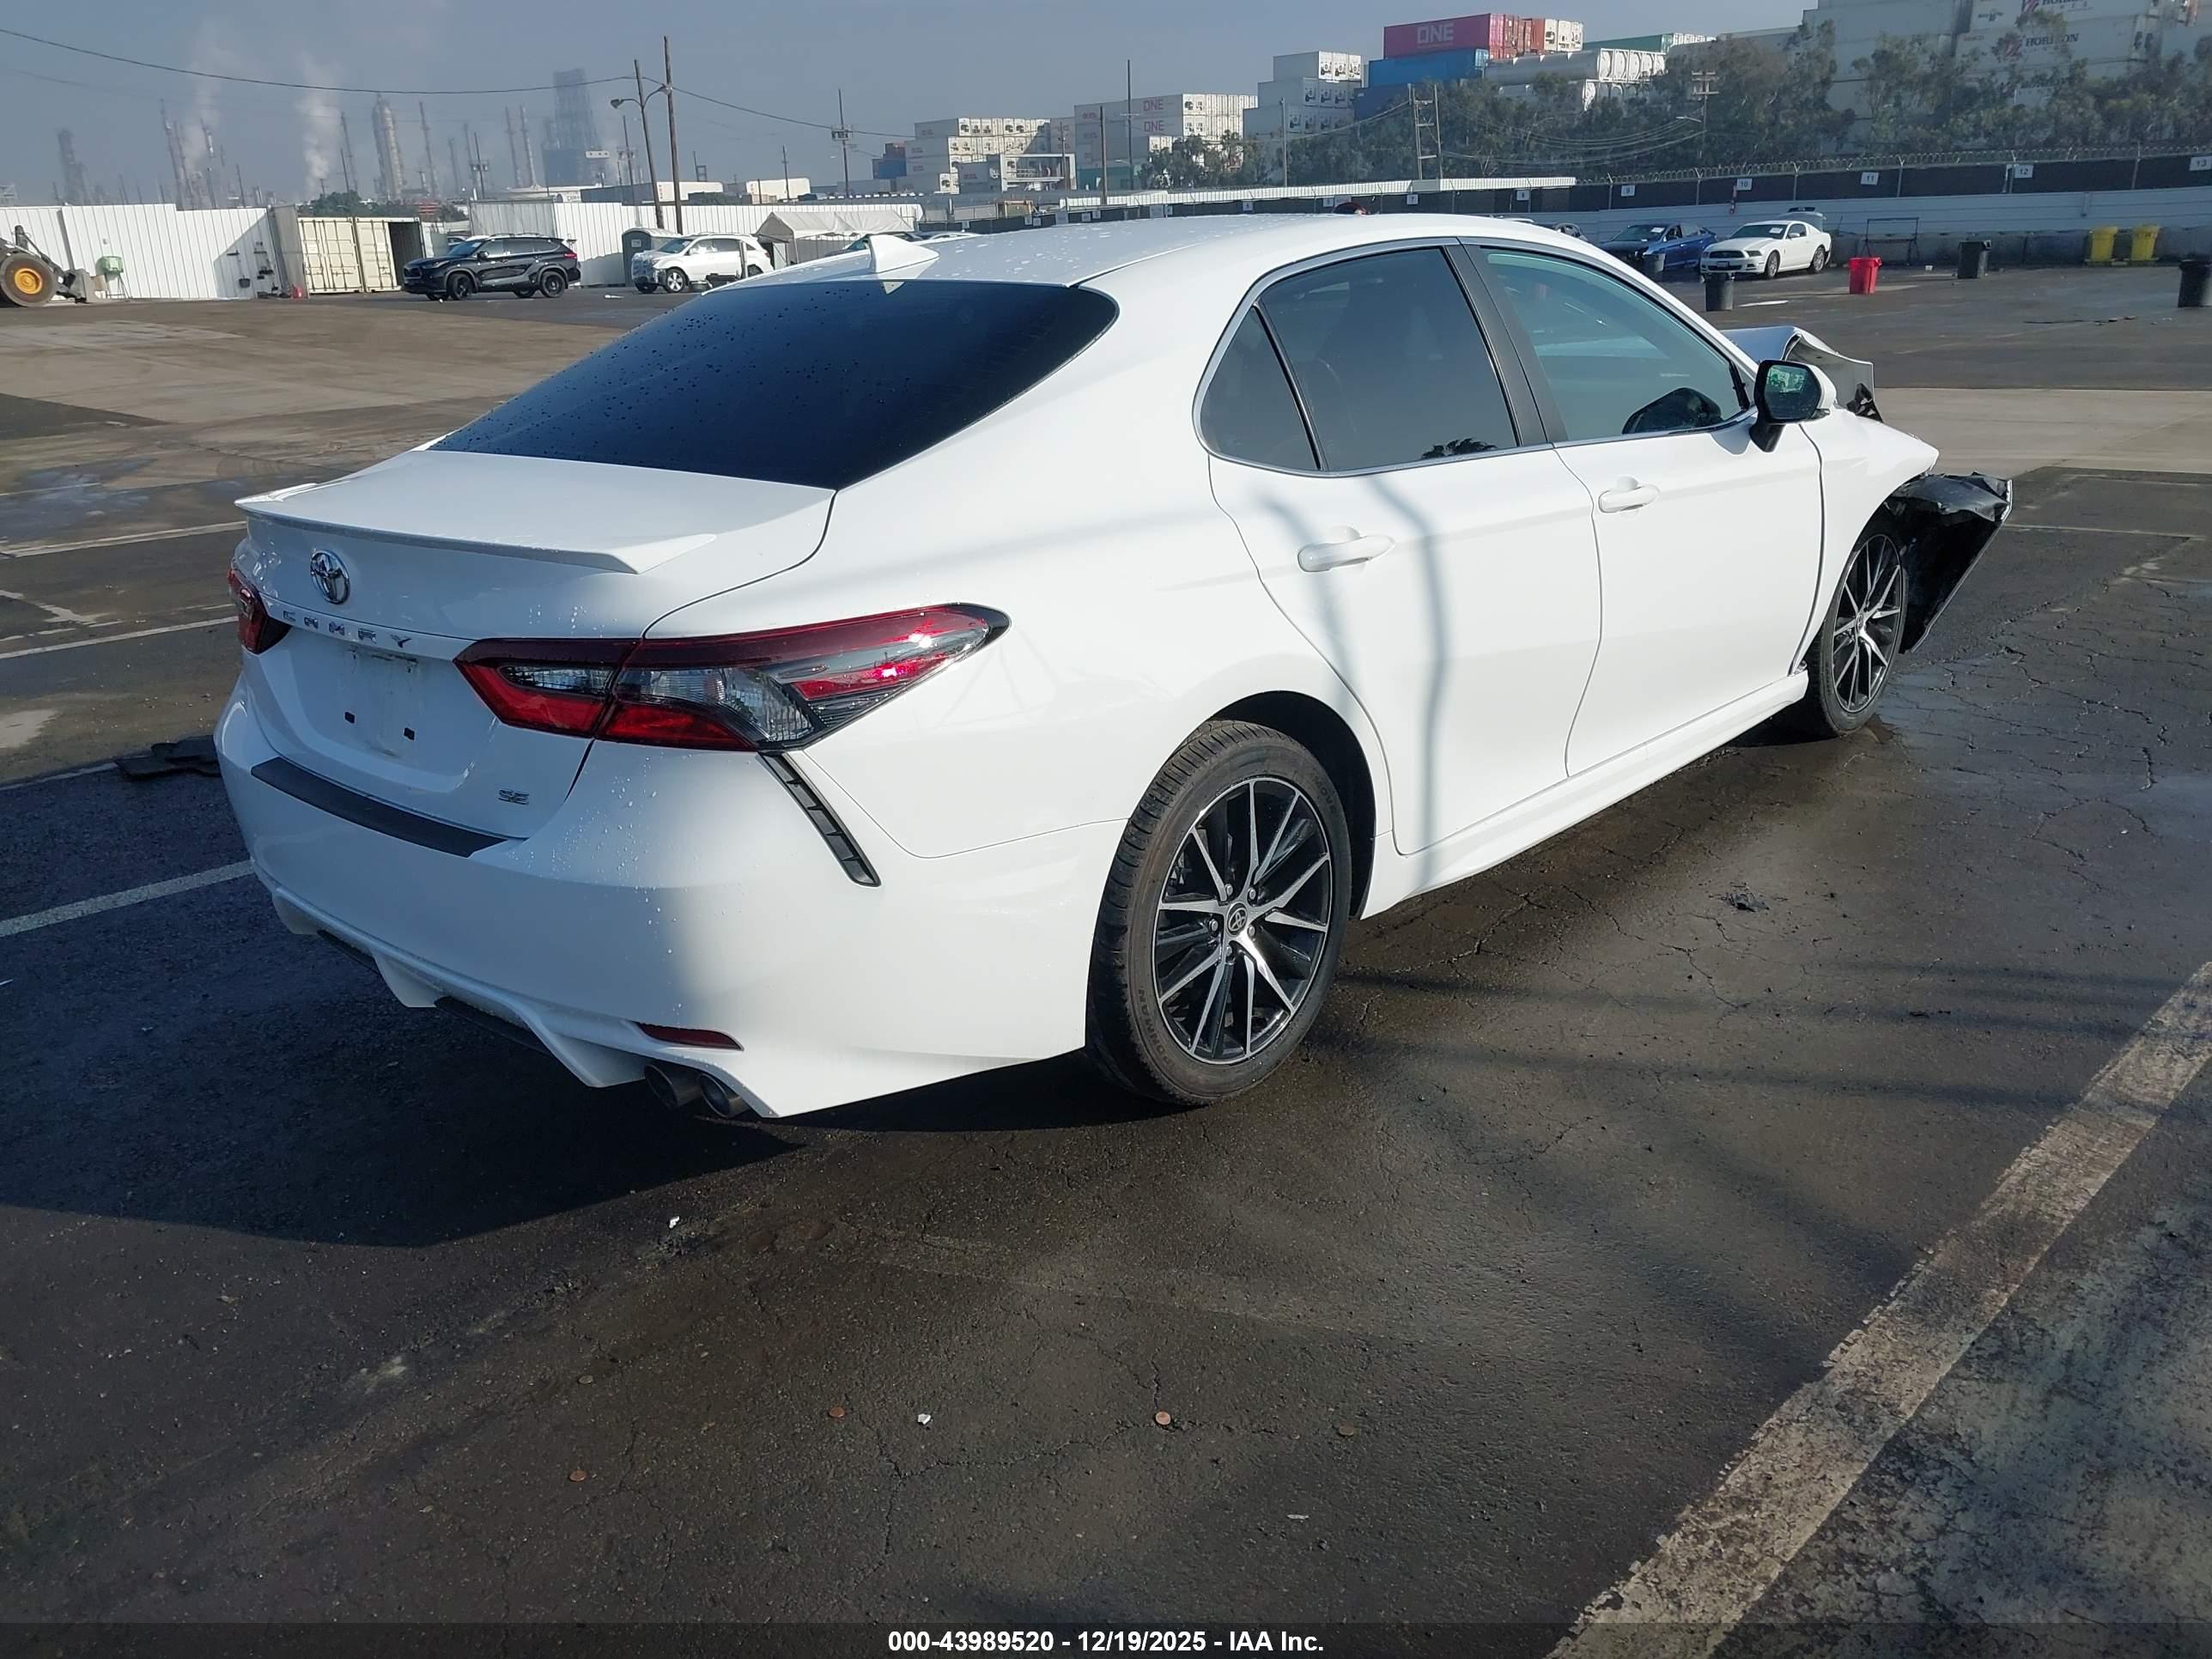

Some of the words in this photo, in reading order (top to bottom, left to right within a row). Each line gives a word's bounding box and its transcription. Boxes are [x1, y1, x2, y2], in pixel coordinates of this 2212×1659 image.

[1417, 22, 1454, 44] ONE
[2026, 33, 2080, 46] HORION
[1143, 99, 1164, 112] ONE
[1144, 120, 1164, 132] ONE
[283, 610, 412, 648] CAMRY
[498, 788, 529, 805] SE
